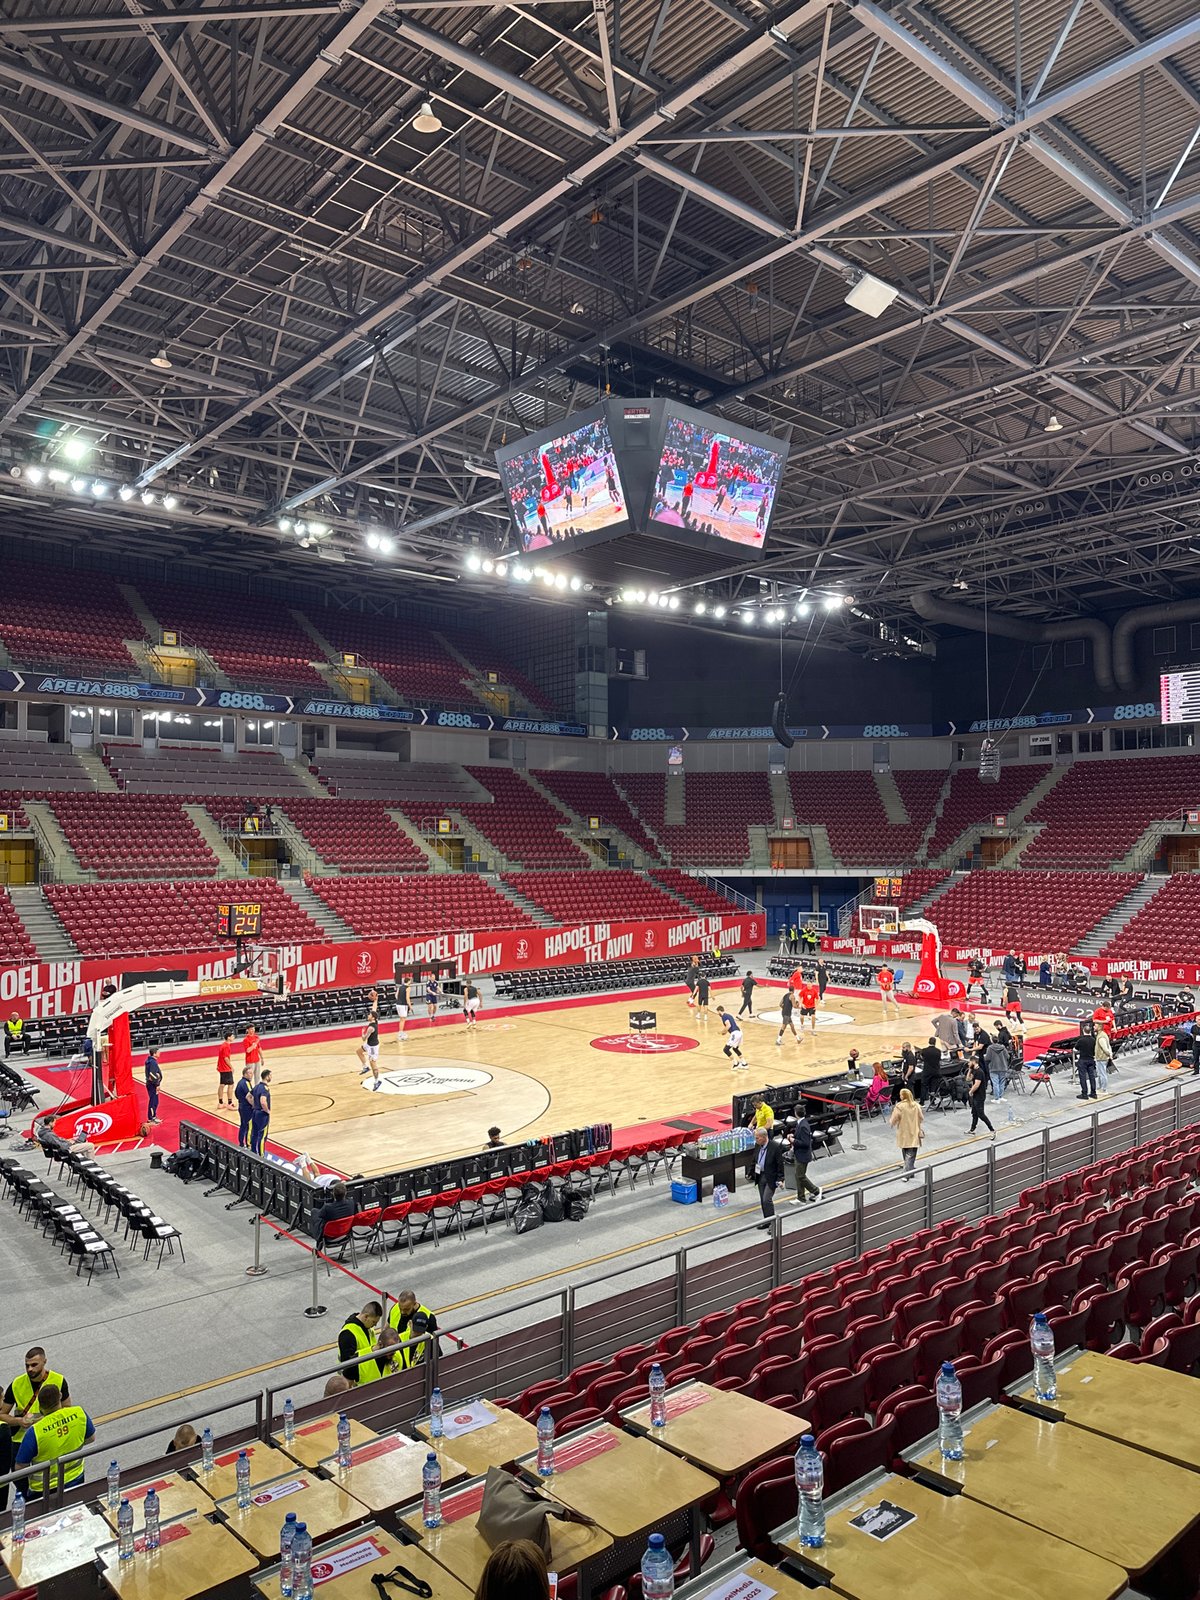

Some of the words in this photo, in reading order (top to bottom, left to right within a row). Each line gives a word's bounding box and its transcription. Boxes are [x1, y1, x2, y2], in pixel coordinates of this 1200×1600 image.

[103, 683, 140, 698] 8888
[352, 706, 381, 719] 8888
[232, 904, 261, 916] 79:08
[234, 916, 258, 932] 24
[667, 916, 708, 948] HAPOEL
[718, 924, 742, 950] AVIV
[544, 924, 593, 960] HAPOEL
[583, 942, 604, 964] TEL
[605, 932, 634, 962] AVIV
[833, 938, 857, 950] HAPOEL
[891, 942, 912, 955] HAPOEL
[468, 942, 503, 975] AVIV
[295, 955, 339, 992] AVIV
[1107, 960, 1138, 974] HAPOEL
[1132, 970, 1147, 982] TEL
[1147, 968, 1169, 981] AVIV
[201, 982, 243, 995] ETIHAD
[27, 988, 67, 1020] TEL
[1041, 994, 1078, 1004] EUROLEAGUE
[1078, 998, 1096, 1006] FINAL
[42, 1413, 79, 1434] SECURITY
[56, 1425, 69, 1438] 99
